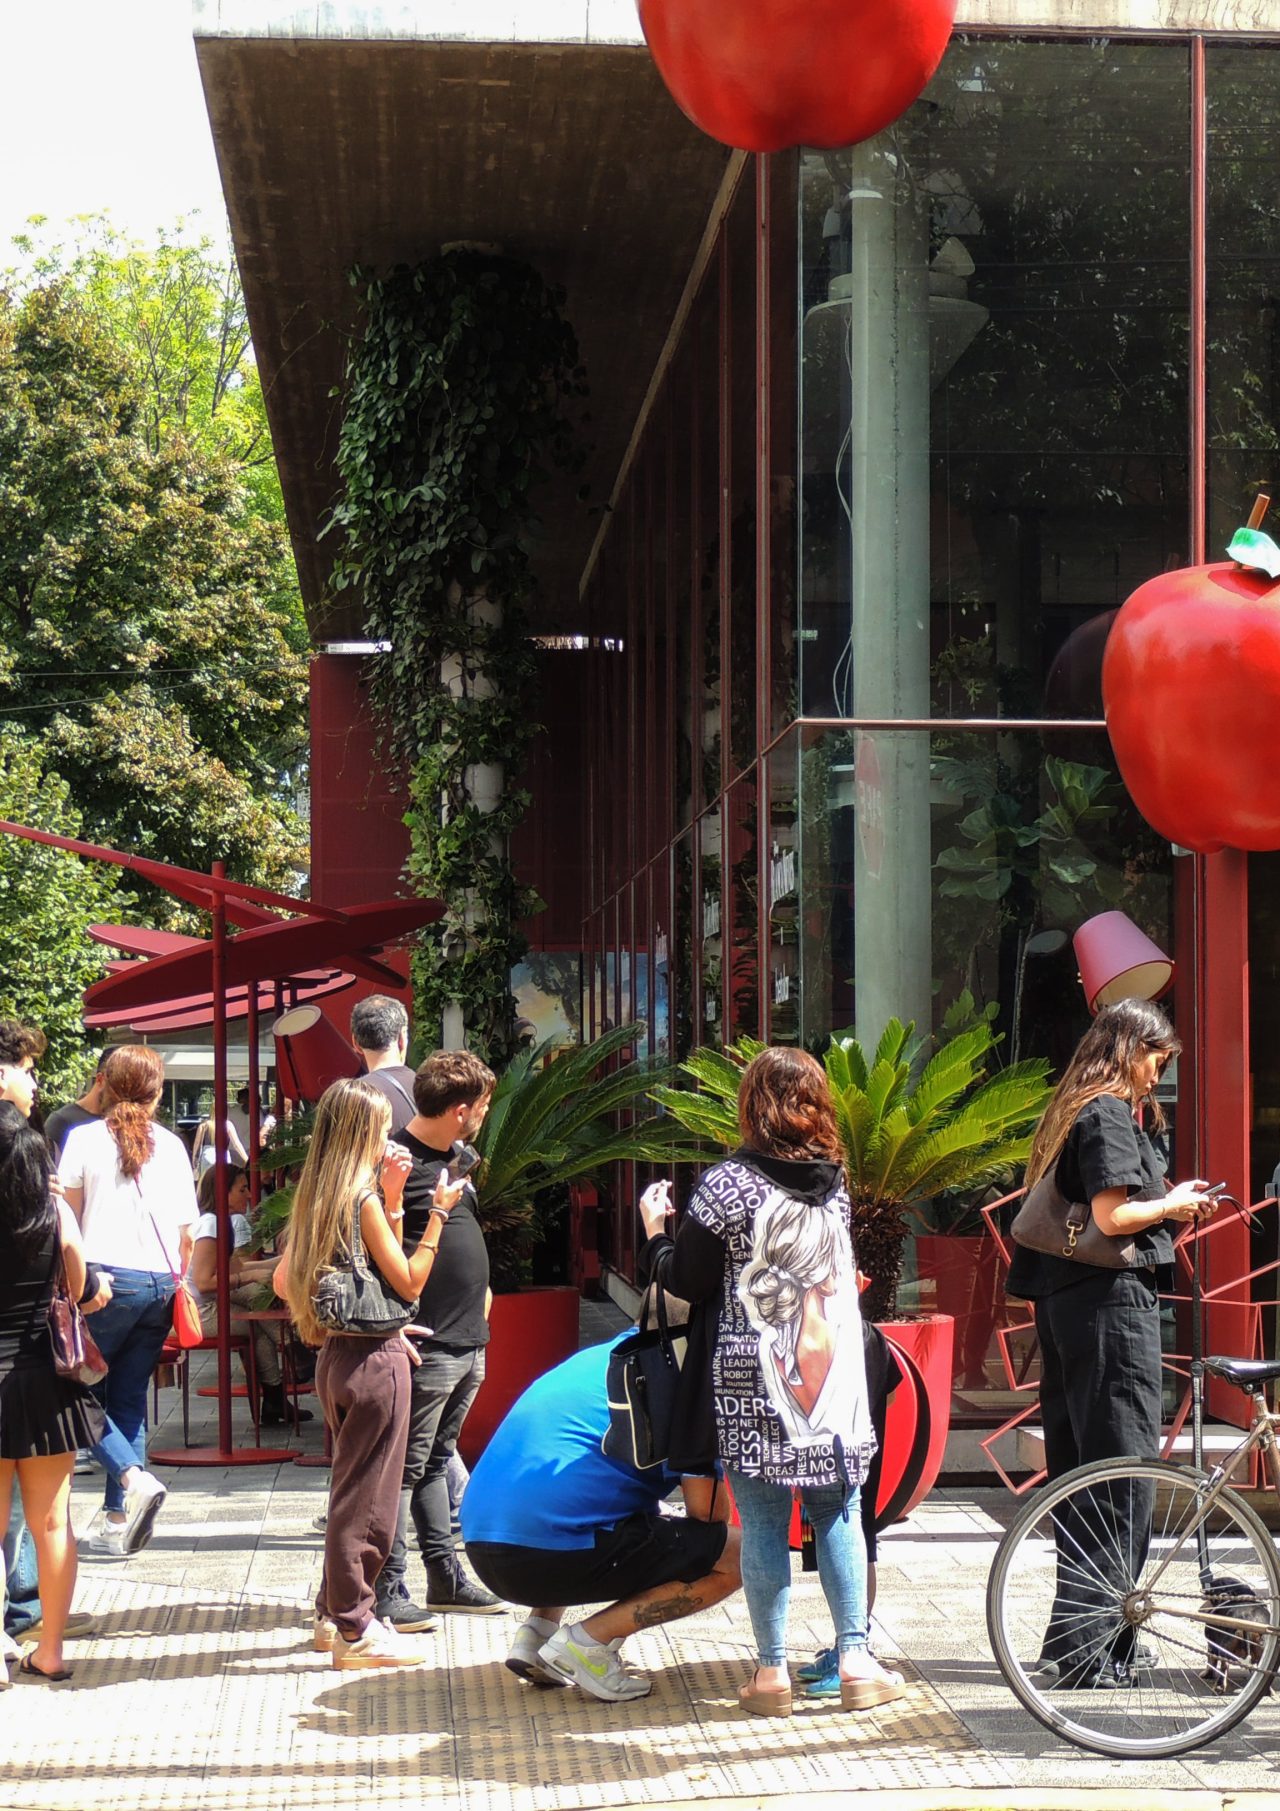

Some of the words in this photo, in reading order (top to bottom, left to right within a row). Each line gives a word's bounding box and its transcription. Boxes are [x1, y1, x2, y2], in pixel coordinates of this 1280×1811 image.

[723, 1370, 753, 1379] ROBOT
[739, 1418, 760, 1428] NET
[727, 1418, 740, 1458] TOOLS
[761, 1420, 770, 1463] TECHNOLOGY
[770, 1420, 781, 1464] INTELLECT
[763, 1466, 795, 1478] IDEAS
